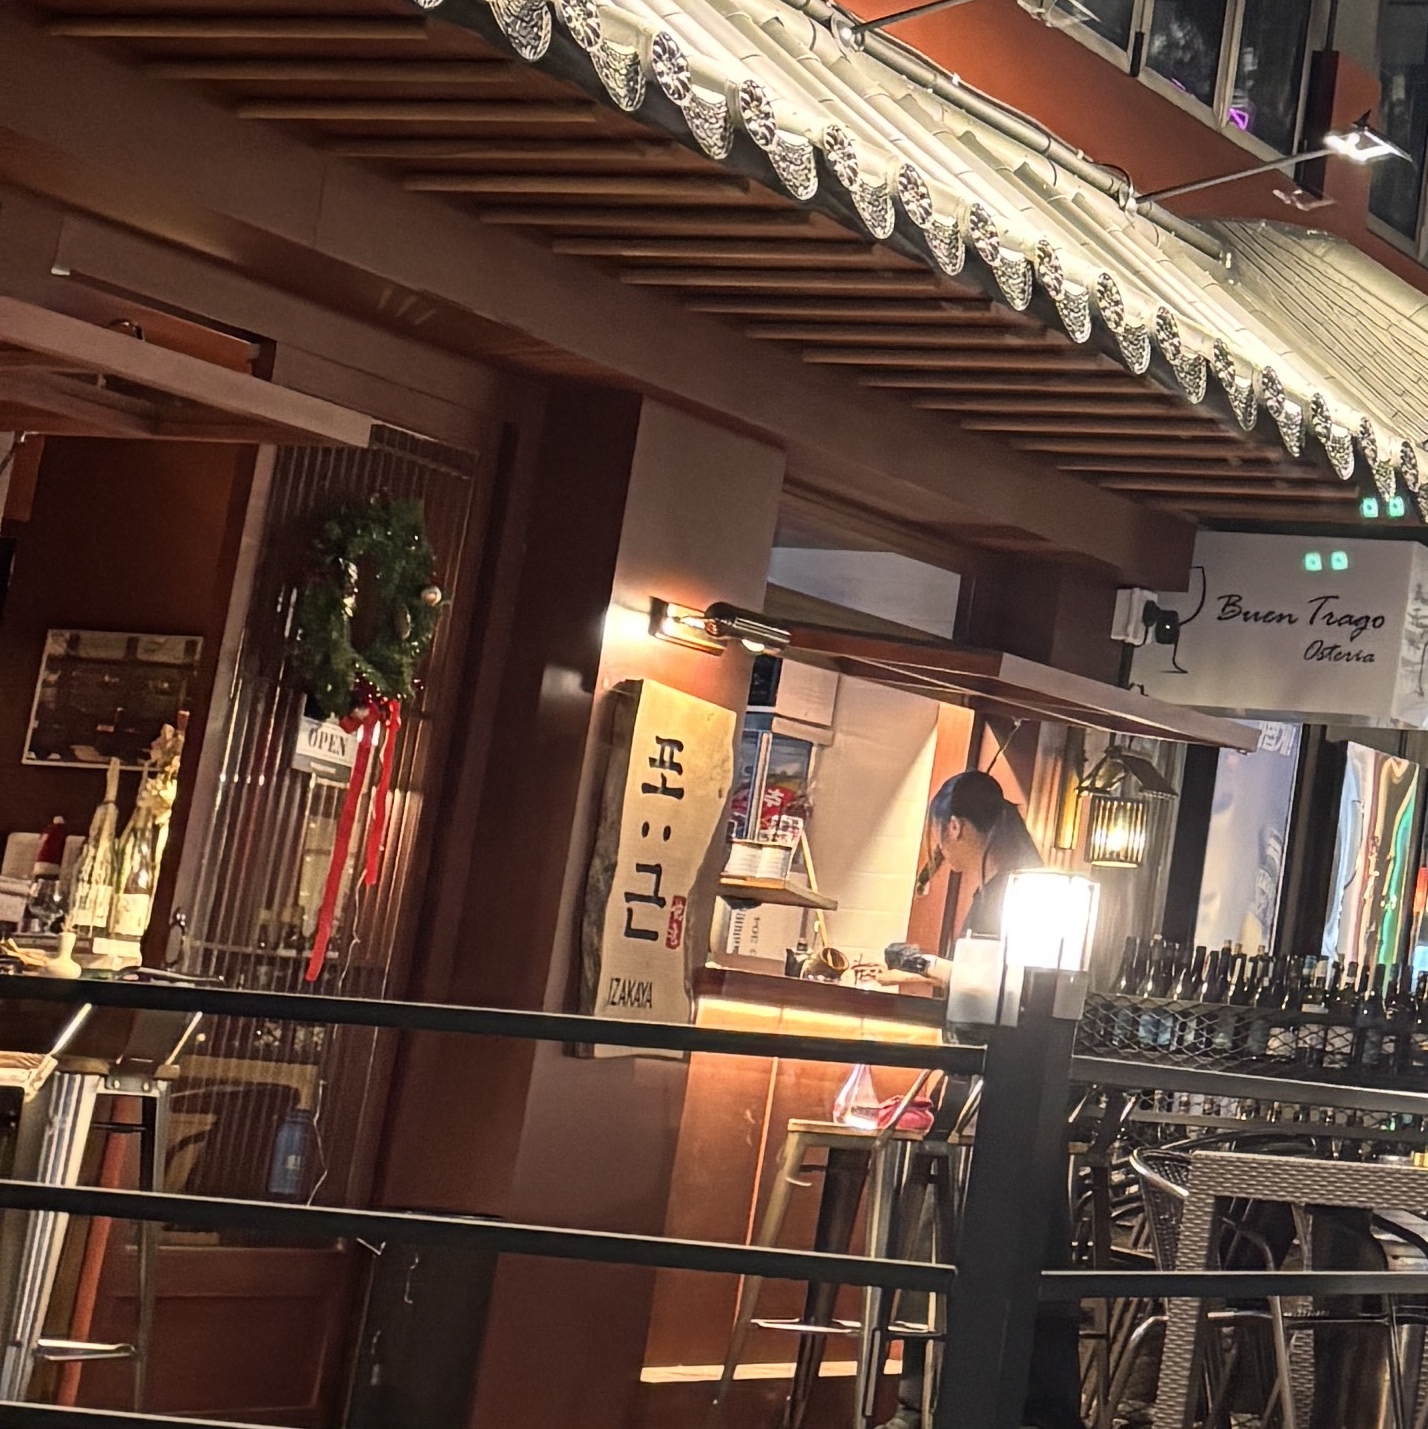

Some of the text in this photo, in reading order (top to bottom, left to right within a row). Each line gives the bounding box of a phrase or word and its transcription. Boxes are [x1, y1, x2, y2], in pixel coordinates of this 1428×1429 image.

[1216, 593, 1387, 642] Buen Trago
[308, 727, 347, 757] OPEN
[605, 976, 654, 1010] IZAKAYA
